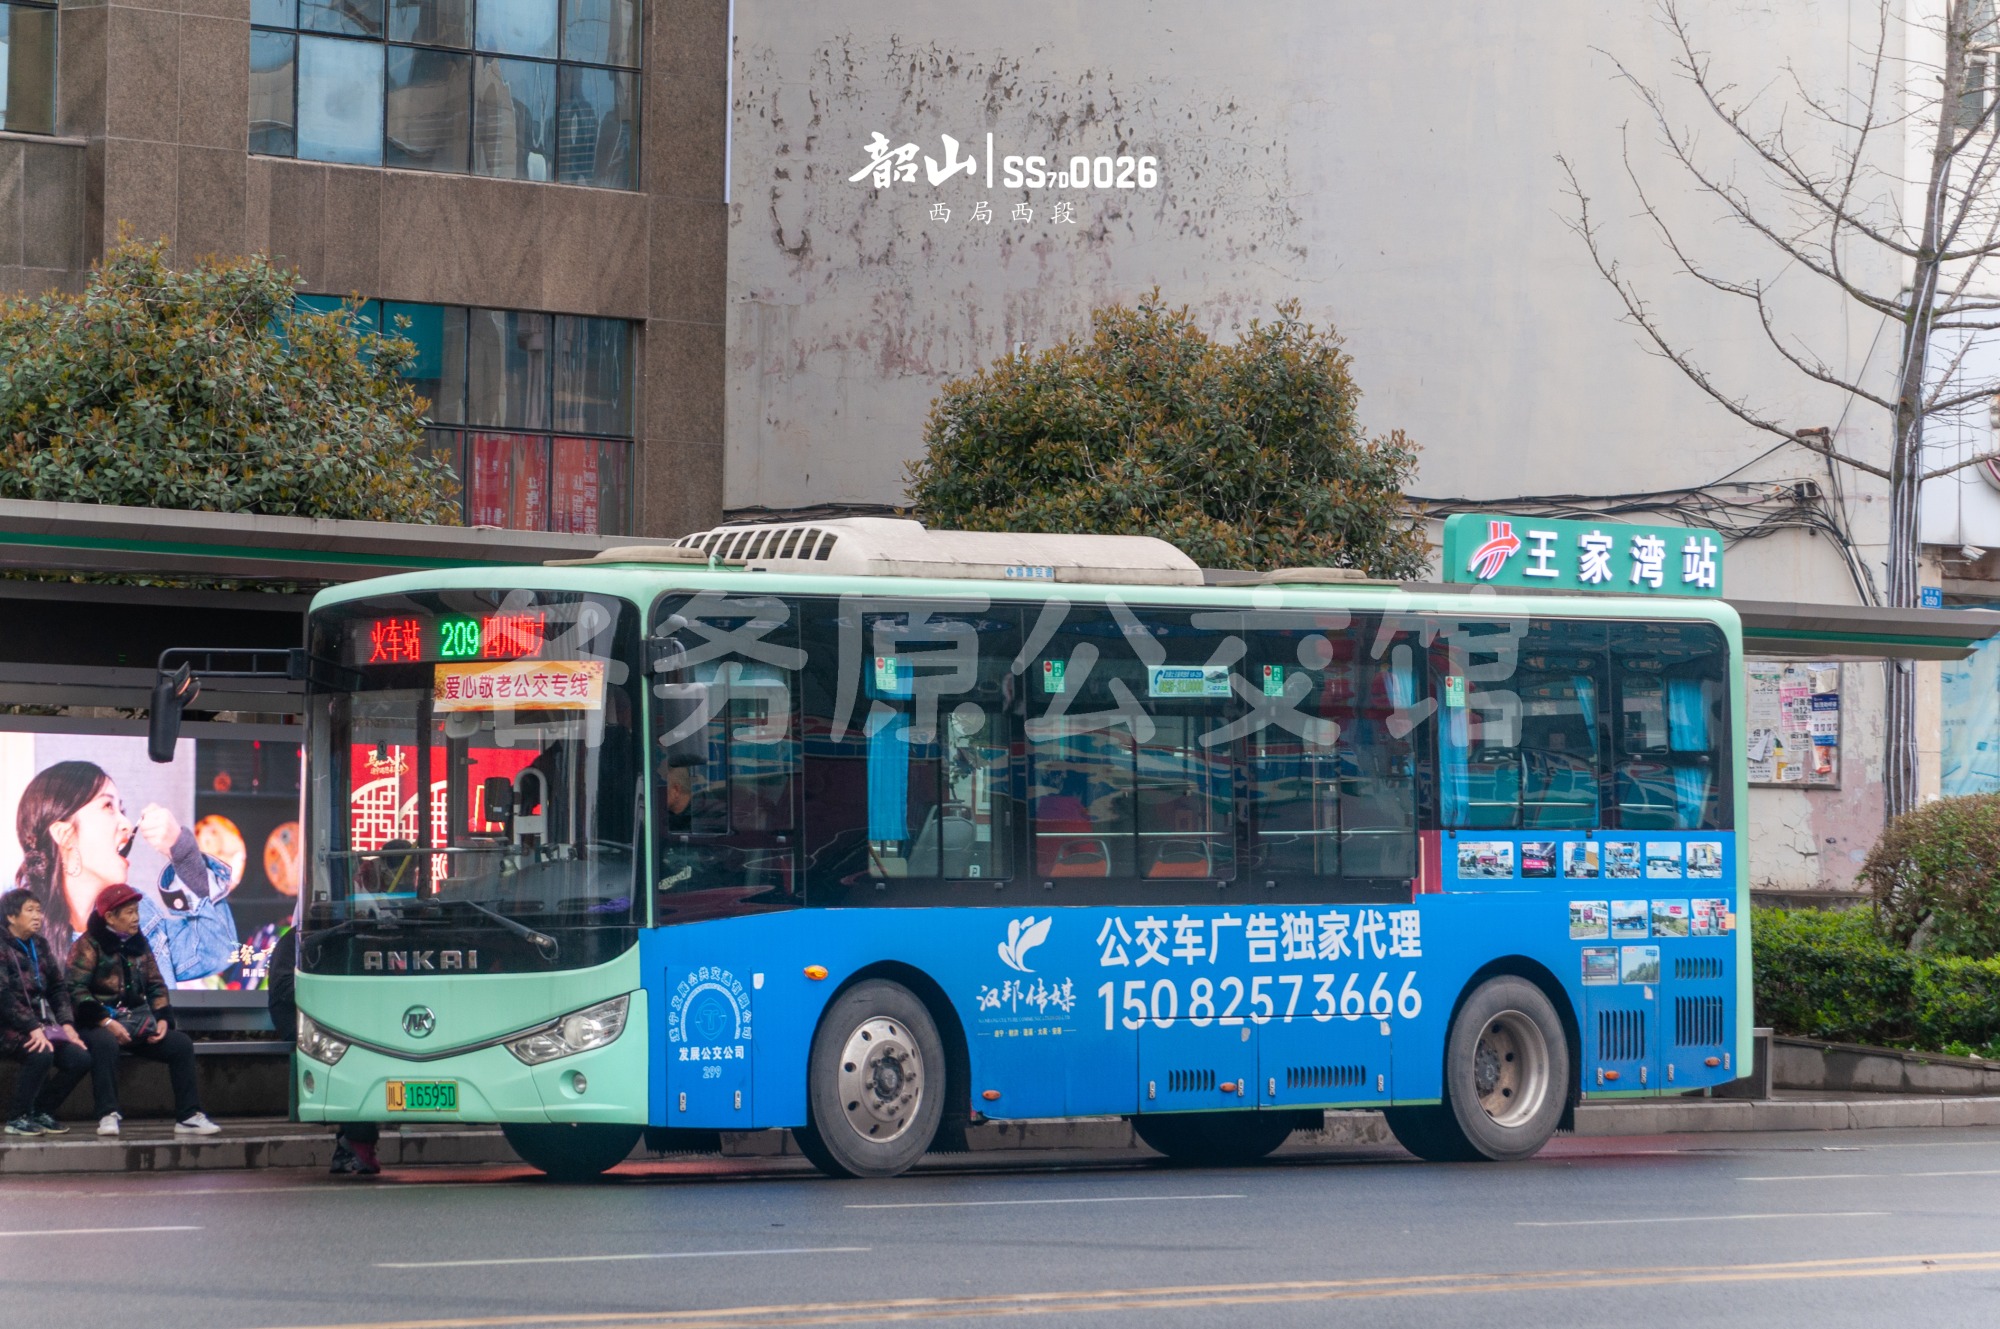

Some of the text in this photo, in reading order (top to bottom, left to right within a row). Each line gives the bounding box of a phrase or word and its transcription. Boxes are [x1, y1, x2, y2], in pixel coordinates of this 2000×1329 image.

[1522, 529, 1718, 589] 王家湾站
[369, 619, 421, 663] 火车站
[441, 621, 480, 656] 209
[445, 673, 589, 700] 爱心敬老公交专线
[1096, 909, 1423, 968] 公交车广告独家代理
[364, 950, 478, 970] ANKAI
[976, 976, 1077, 1015] 汉邦传媒
[678, 1045, 745, 1061] 发展公交公司
